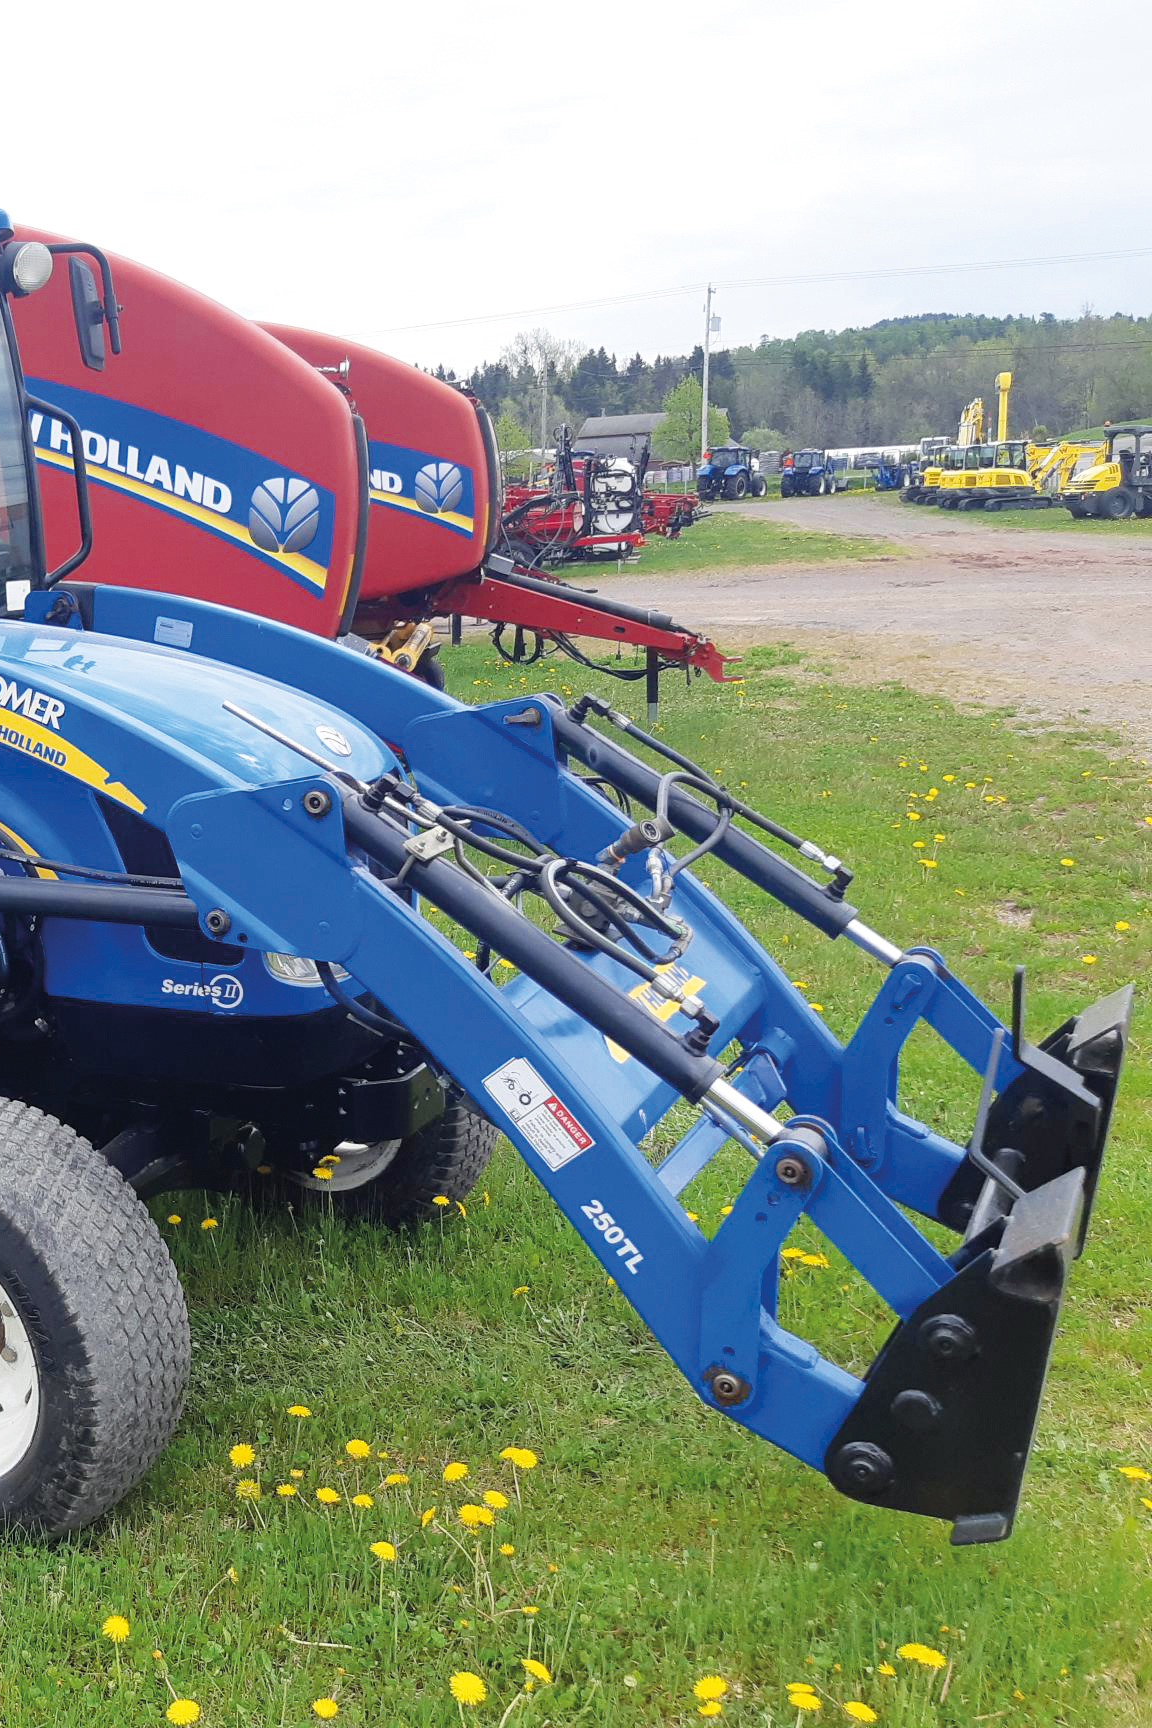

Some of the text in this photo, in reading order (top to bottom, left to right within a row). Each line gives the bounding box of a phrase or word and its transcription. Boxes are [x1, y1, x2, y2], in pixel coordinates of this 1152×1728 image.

[50, 418, 233, 514] HOLLAND
[161, 978, 223, 998] Series
[555, 1108, 586, 1145] DANGER
[580, 1199, 645, 1276] 250TL
